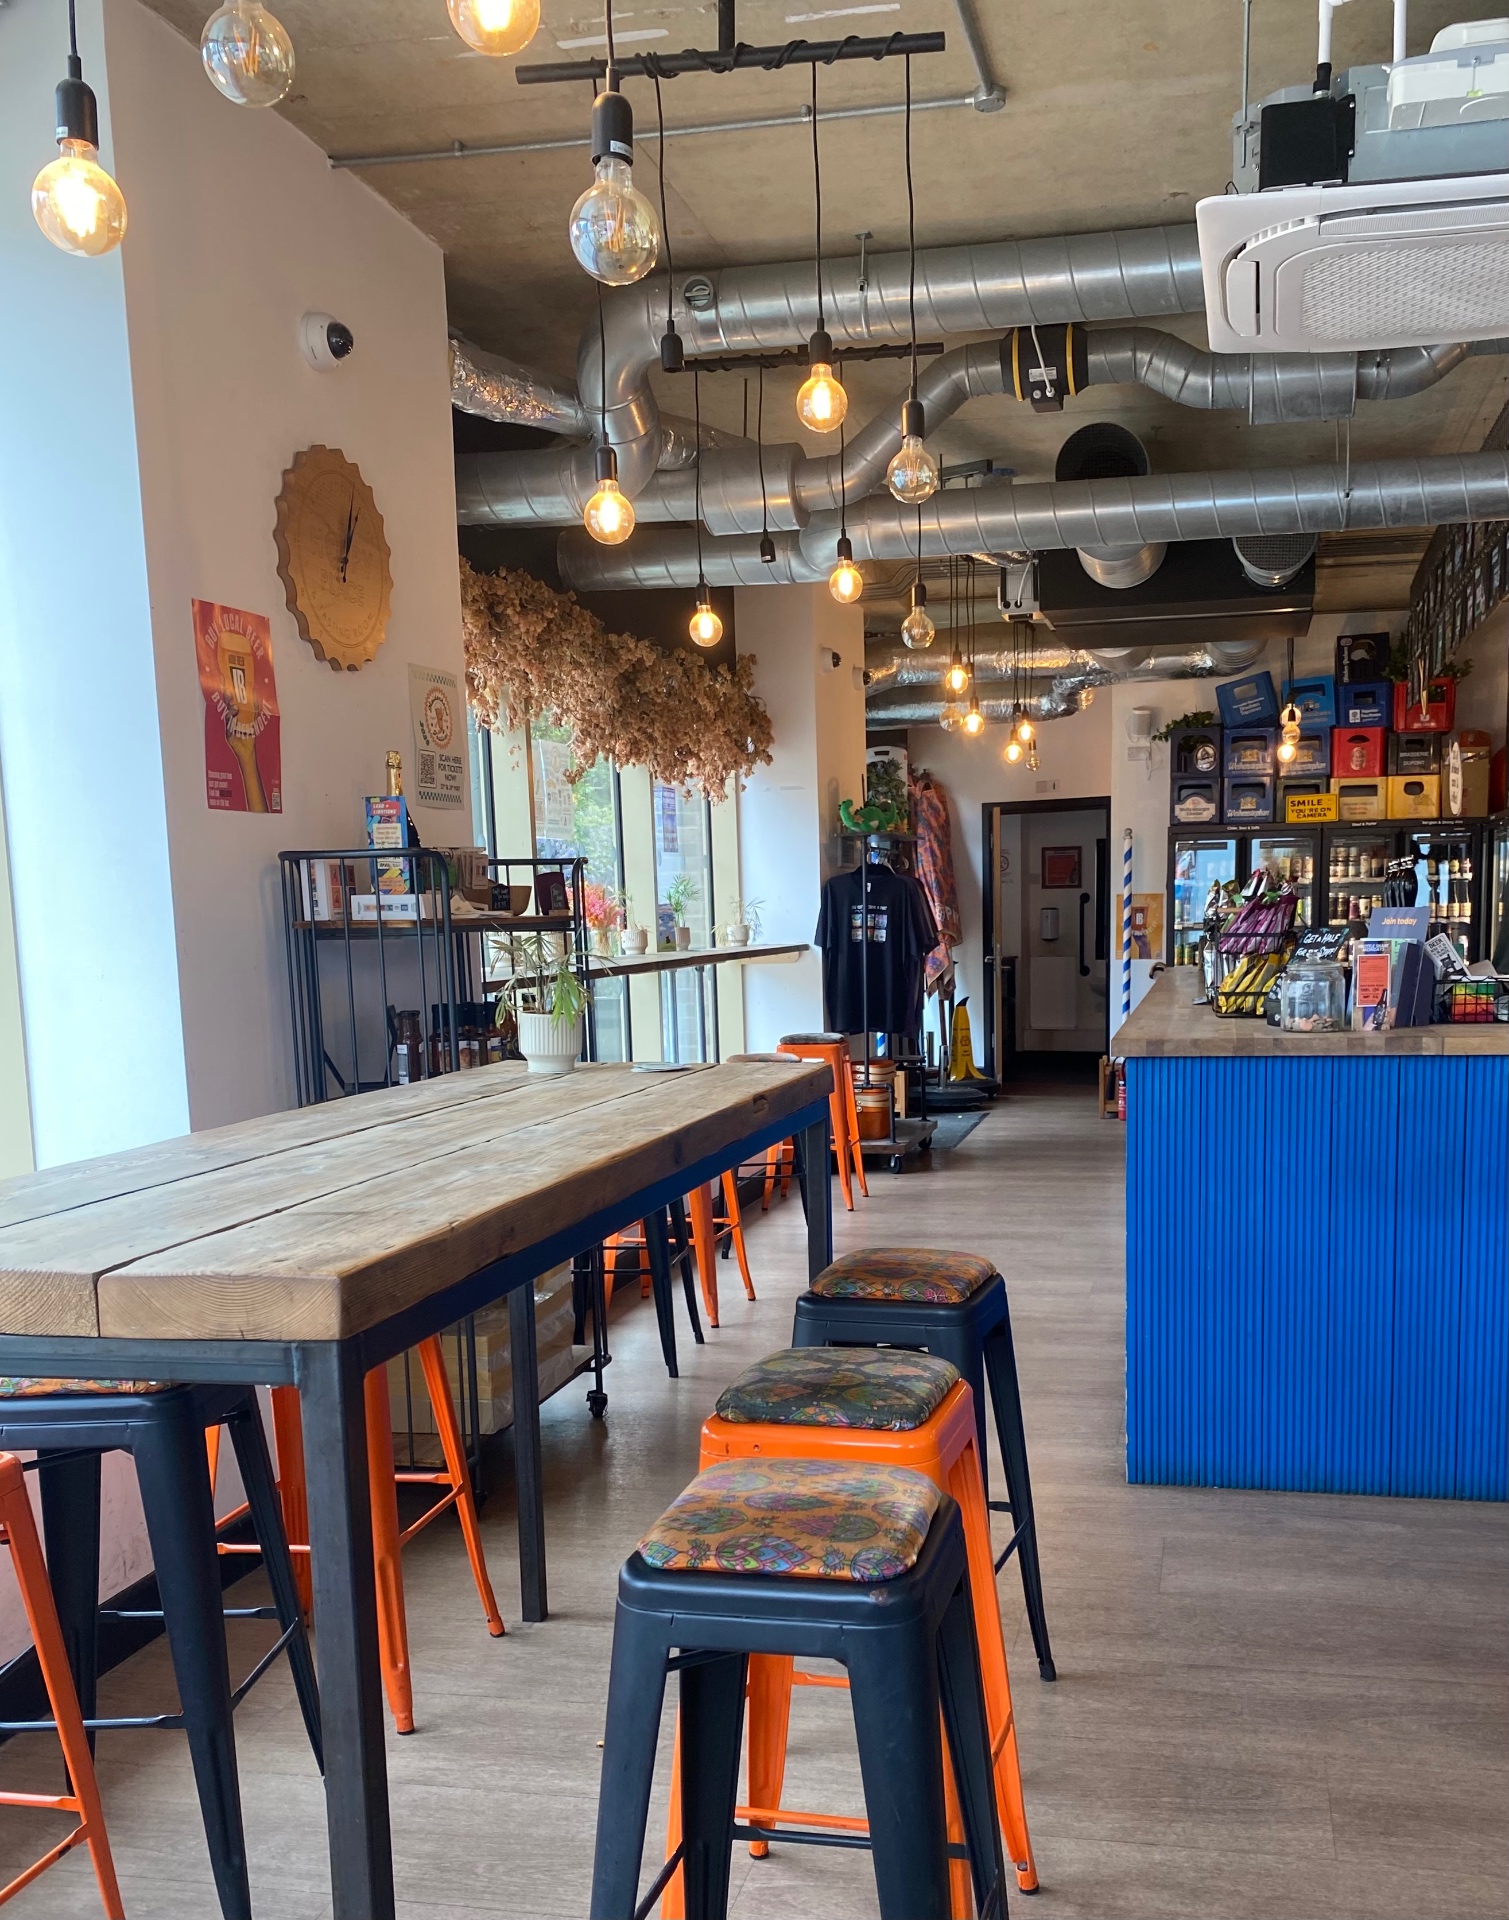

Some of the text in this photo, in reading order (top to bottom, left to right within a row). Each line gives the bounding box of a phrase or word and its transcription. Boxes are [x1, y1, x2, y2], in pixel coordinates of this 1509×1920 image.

[204, 621, 221, 649] BUY
[219, 613, 245, 634] LOCAL
[245, 624, 265, 660] BEER
[211, 691, 230, 721] BUY
[1290, 798, 1323, 808] SMILE
[1381, 917, 1418, 926] Join today
[1303, 933, 1319, 944] GET
[1321, 933, 1341, 944] HALF
[1295, 947, 1307, 957] FOR
